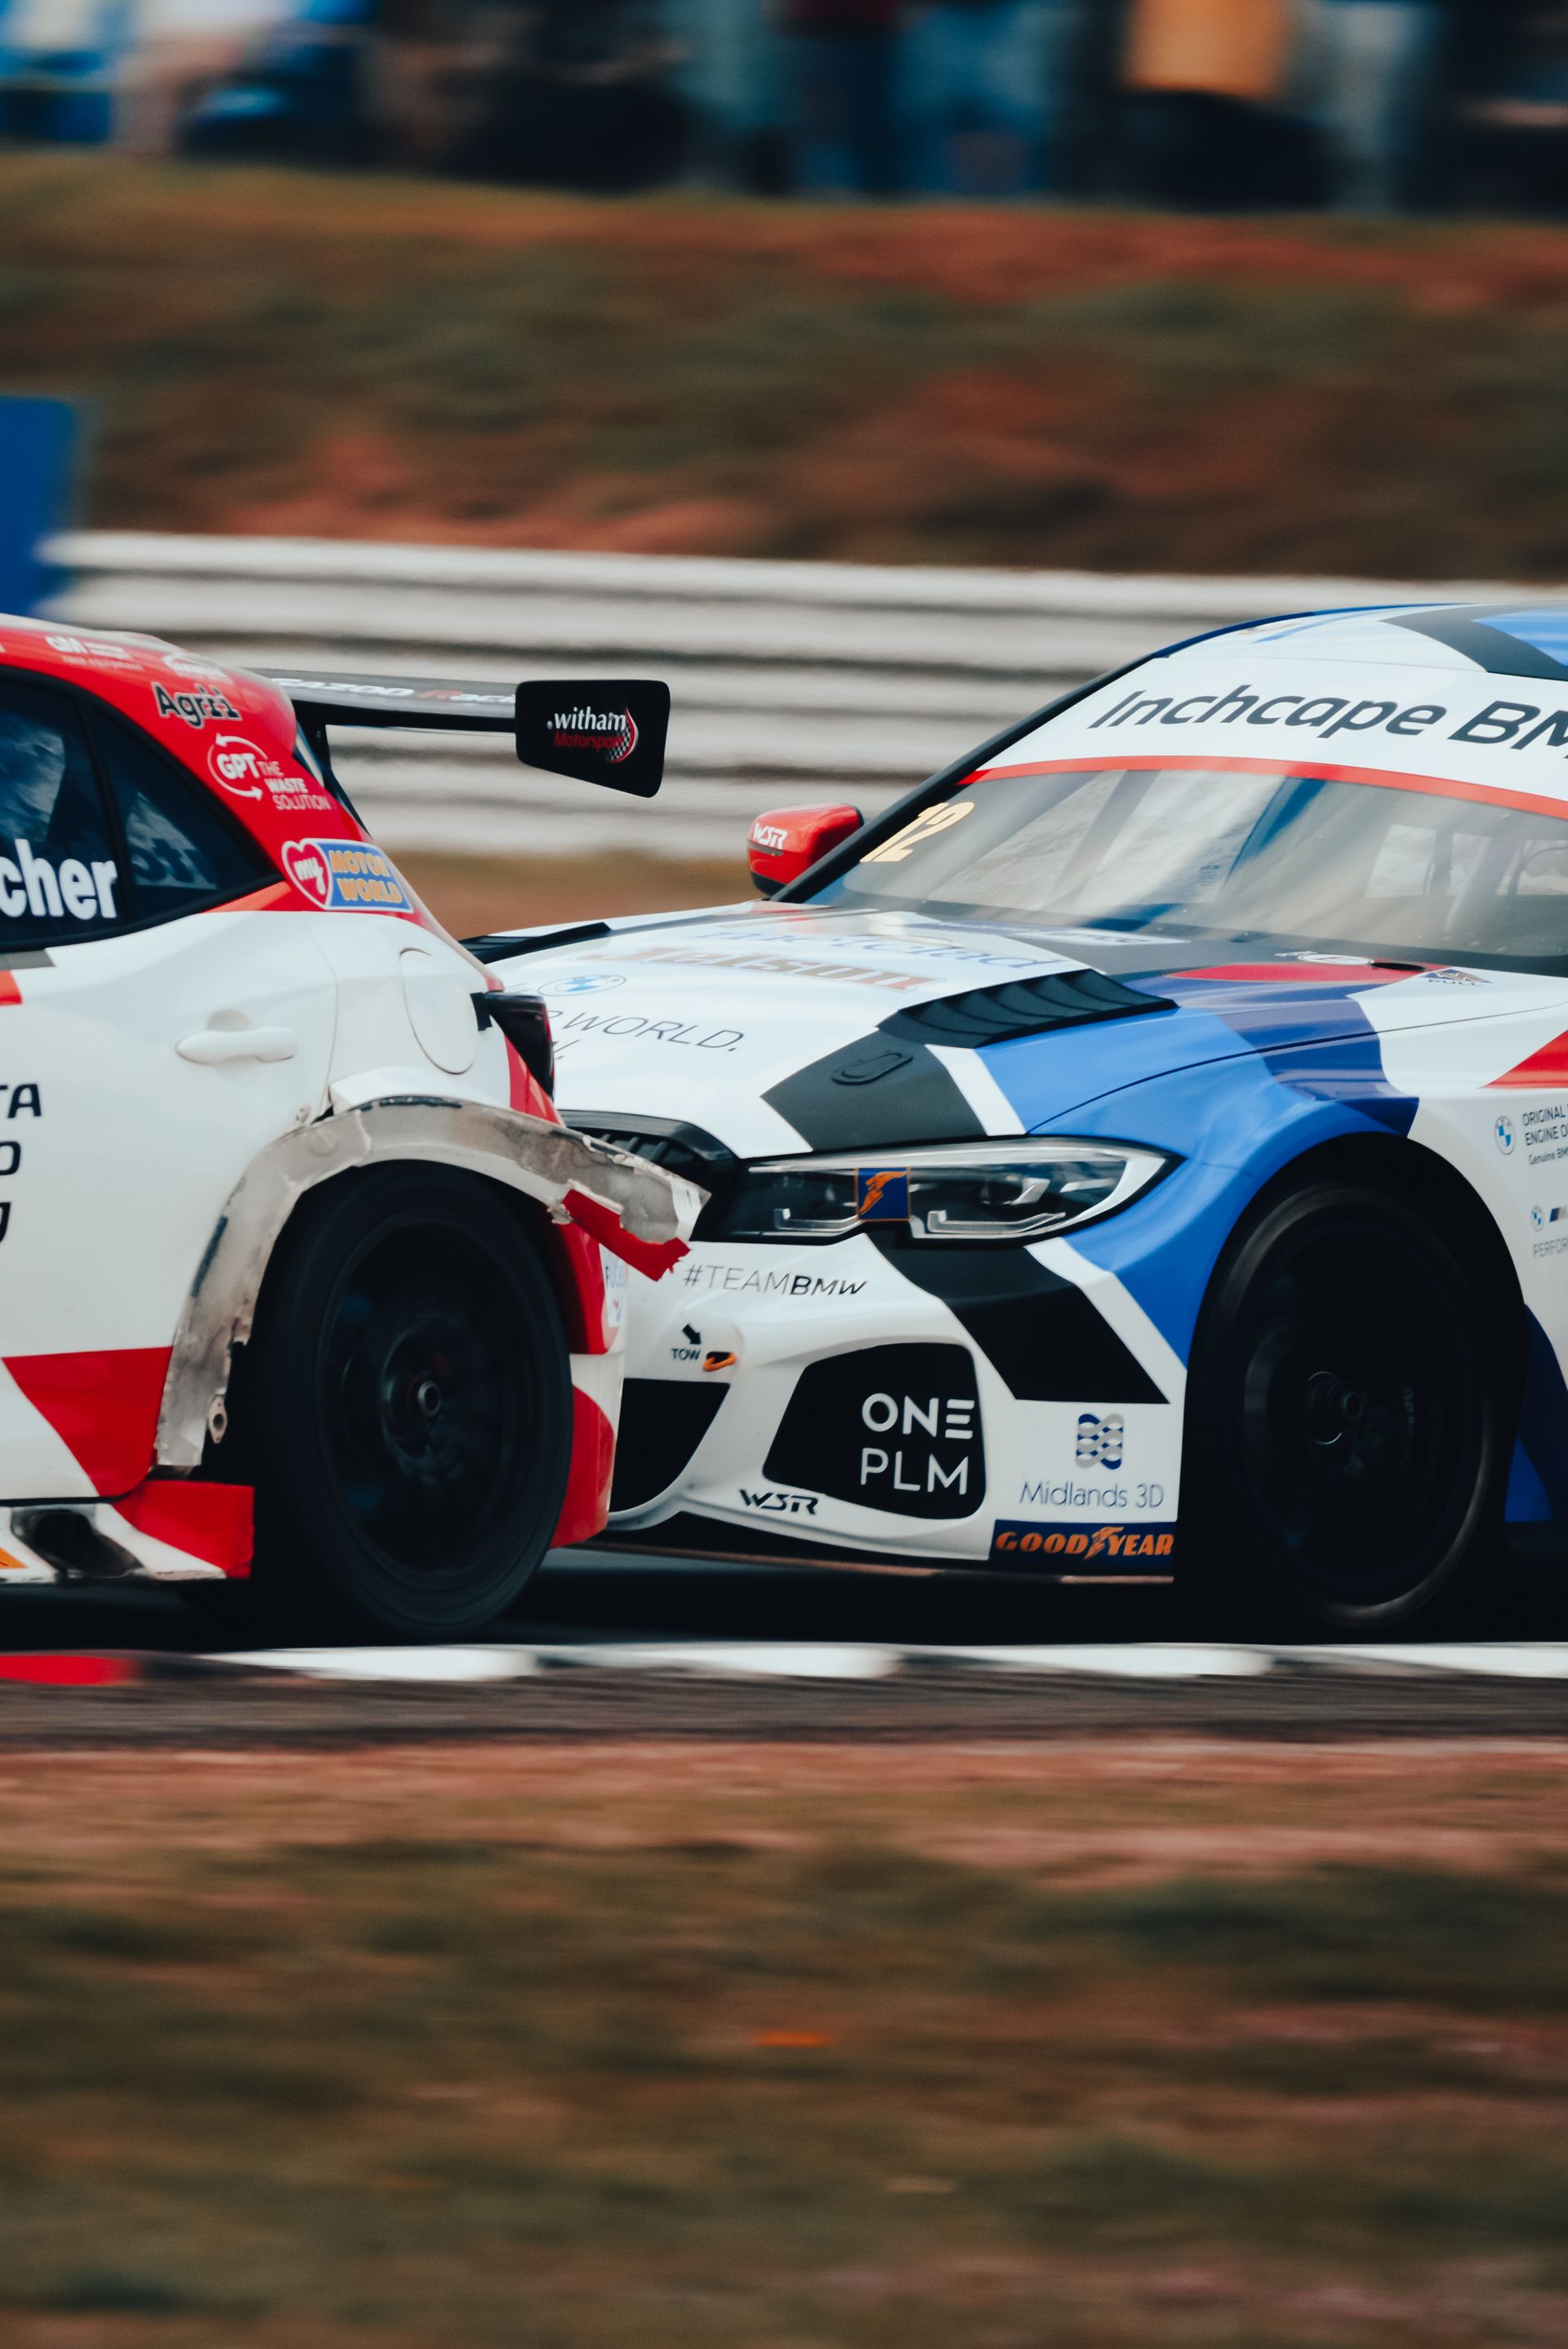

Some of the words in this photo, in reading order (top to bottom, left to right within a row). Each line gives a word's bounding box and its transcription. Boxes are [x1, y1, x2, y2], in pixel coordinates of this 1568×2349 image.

[151, 682, 243, 729] Agrii
[554, 706, 626, 731] witham
[1086, 684, 1448, 739] Inchcape
[554, 730, 625, 751] Motorsport
[216, 753, 261, 779] GPT
[256, 761, 284, 776] THE
[264, 778, 309, 794] WASTE
[272, 795, 332, 811] SOLUTION
[753, 822, 788, 849] WSR
[859, 802, 974, 862] 12
[328, 850, 391, 877] MOTOR
[0, 838, 118, 920] cher
[336, 878, 403, 903] WORLD
[562, 1012, 746, 1052] WORLD.
[1522, 1104, 1566, 1126] ORIGINAL
[1525, 1126, 1559, 1146] ENGINE
[683, 1264, 868, 1295] #TEAMBMW
[670, 1348, 702, 1362] TOW
[862, 1393, 975, 1440] ONE
[860, 1446, 969, 1495] PLM
[739, 1489, 818, 1515] WSR
[1019, 1480, 1129, 1509] Midlands
[1134, 1482, 1165, 1509] 3D
